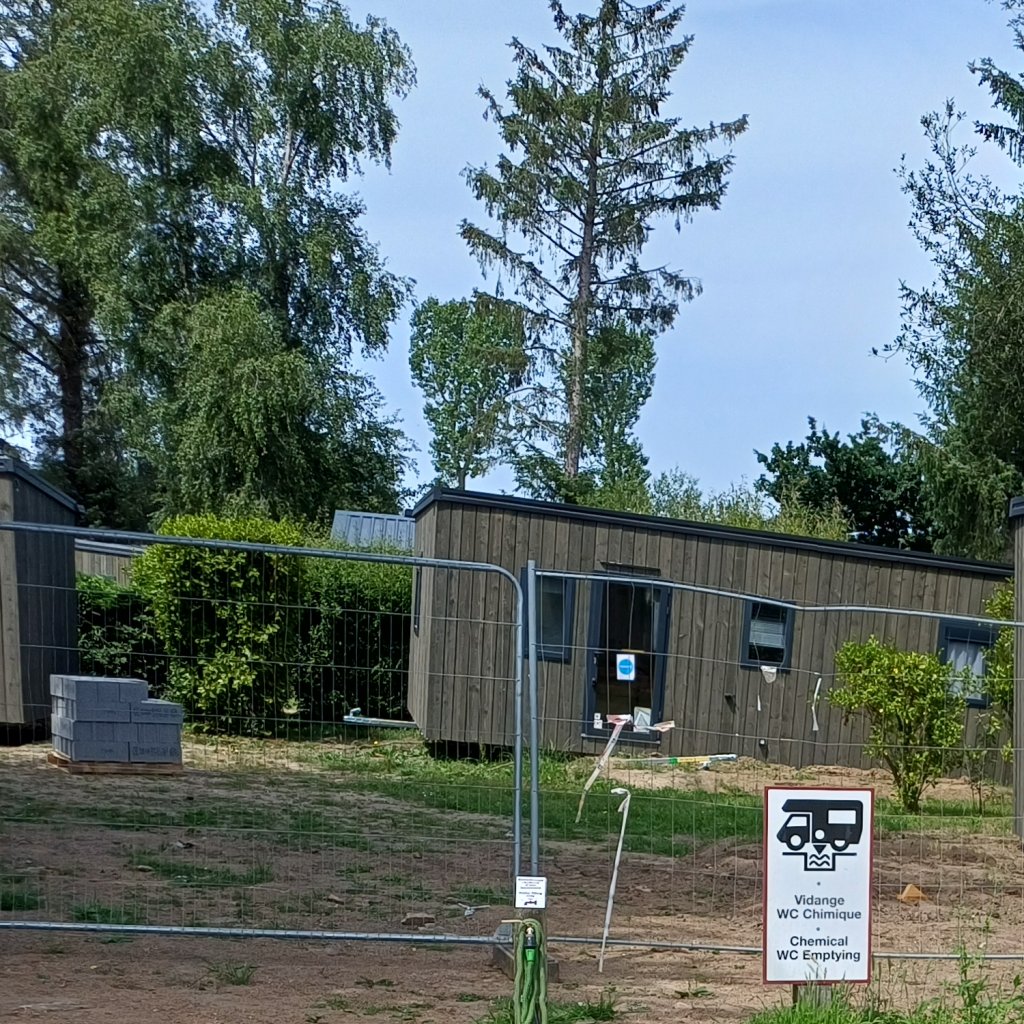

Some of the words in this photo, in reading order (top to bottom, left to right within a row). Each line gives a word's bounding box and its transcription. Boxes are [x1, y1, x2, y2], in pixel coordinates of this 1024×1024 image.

[794, 894, 845, 907] Vidange
[776, 908, 799, 919] WC
[803, 908, 862, 921] Chimique
[790, 935, 848, 947] Chemical
[776, 949, 799, 961] WC
[802, 949, 861, 962] Emptying
